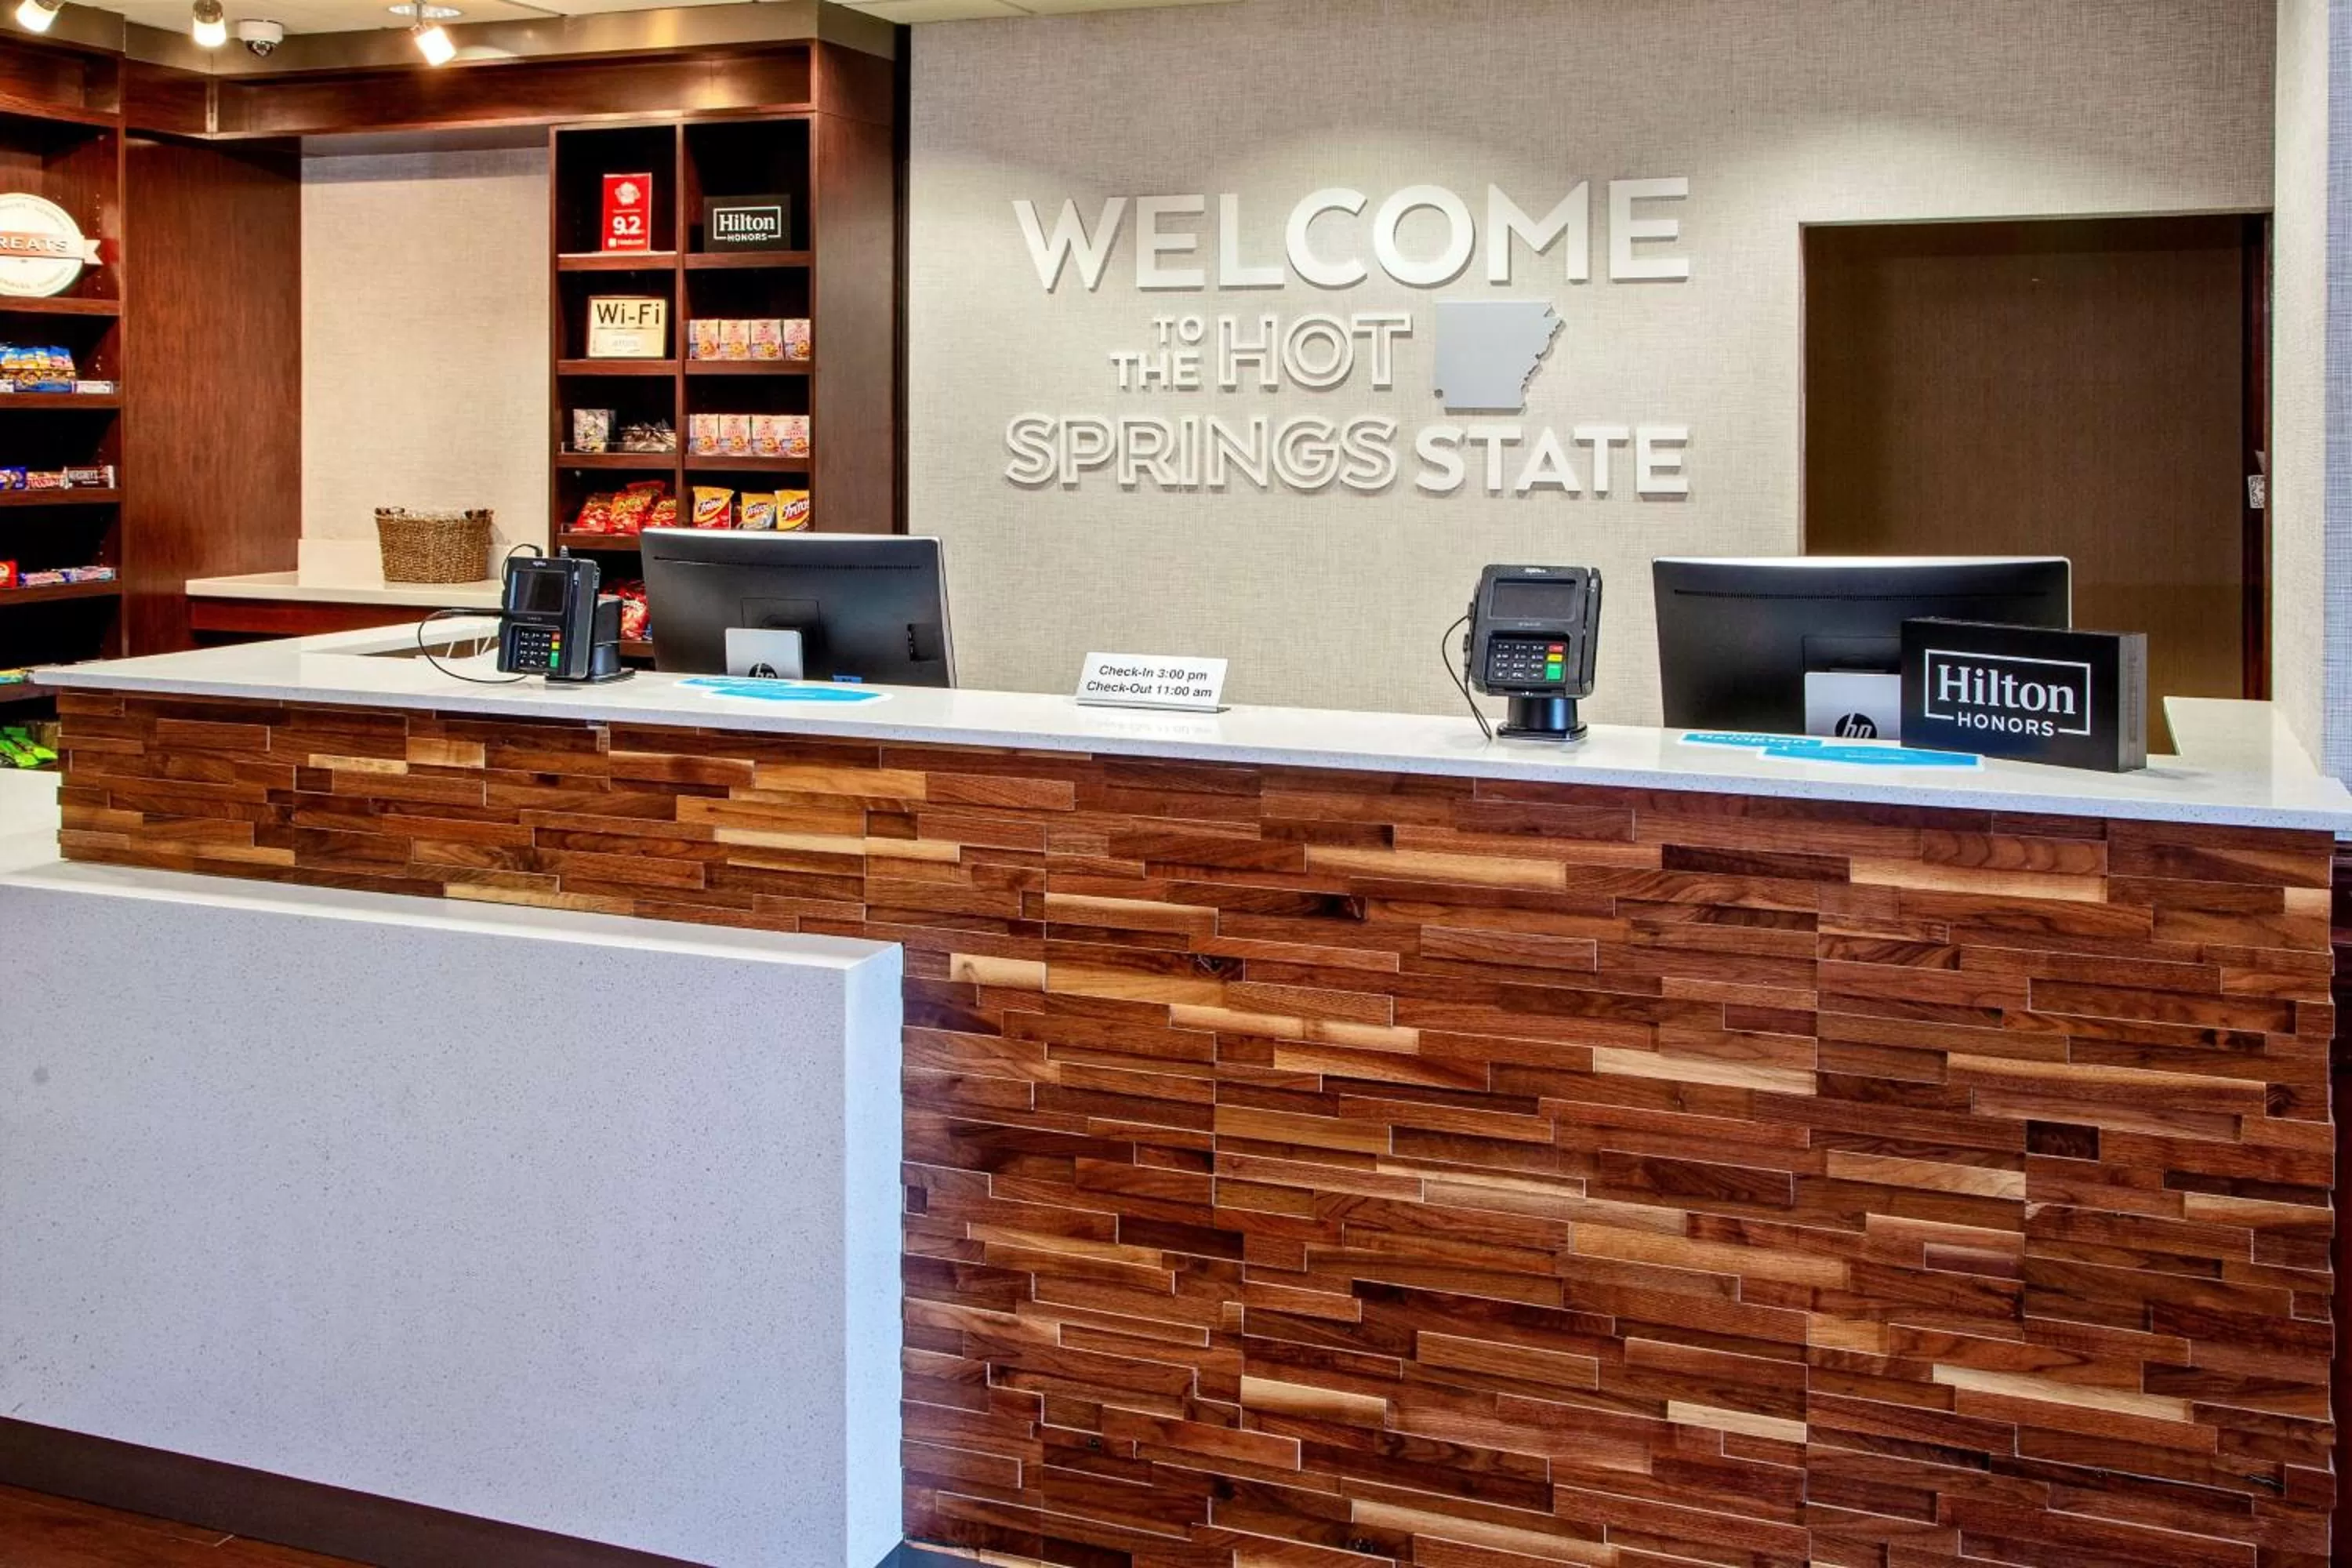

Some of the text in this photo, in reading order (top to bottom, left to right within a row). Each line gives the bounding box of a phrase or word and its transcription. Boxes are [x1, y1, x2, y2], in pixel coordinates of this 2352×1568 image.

[719, 213, 775, 232] Hilton
[1012, 177, 1690, 292] WELCOME
[597, 303, 660, 325] Wi-Fi
[1155, 314, 1204, 346] TO
[1109, 311, 1413, 390] THE HOT
[1004, 412, 1690, 495] SPRINGS STATE
[1087, 680, 1214, 698] Check-Out 11:00 am
[1098, 665, 1208, 684] Check-In 3:00 pm
[1937, 663, 2076, 715] Hilton
[1957, 711, 2055, 737] HONORS
